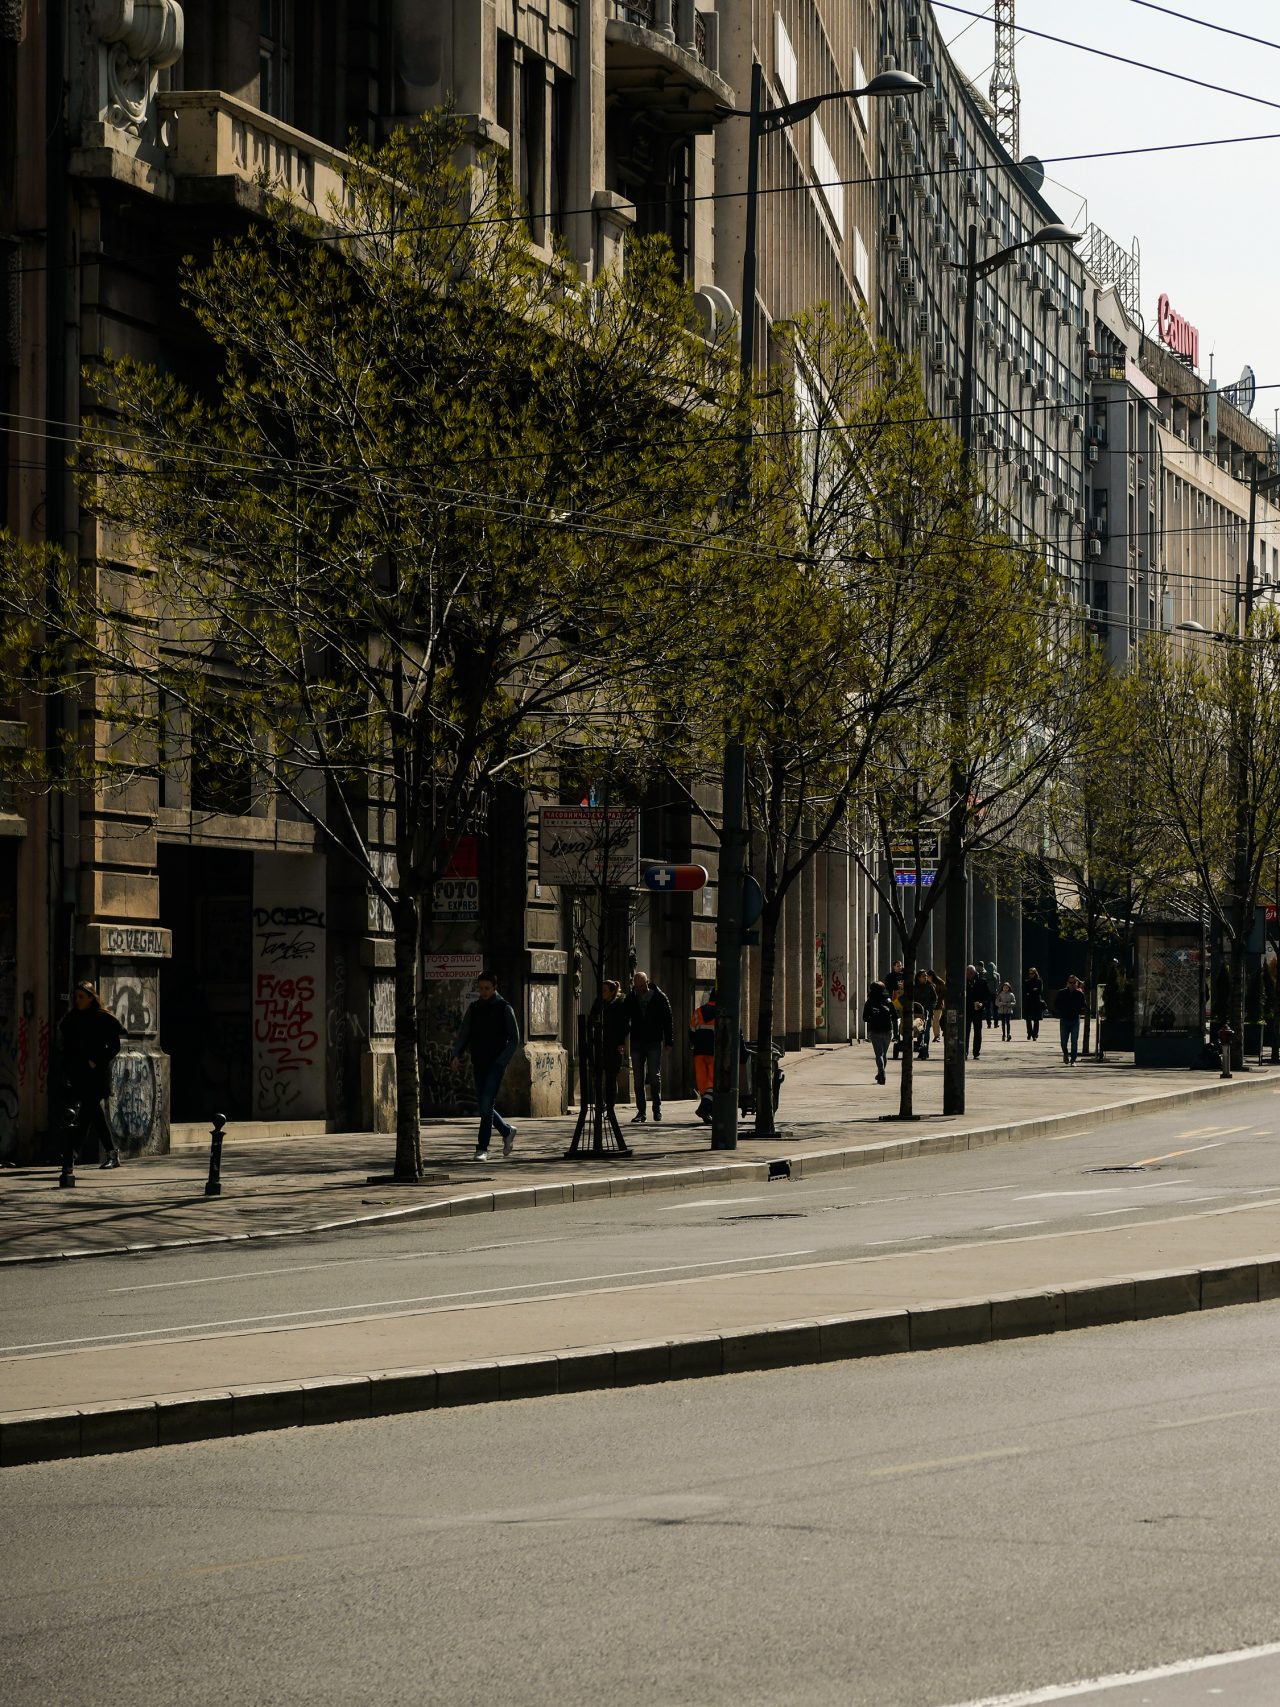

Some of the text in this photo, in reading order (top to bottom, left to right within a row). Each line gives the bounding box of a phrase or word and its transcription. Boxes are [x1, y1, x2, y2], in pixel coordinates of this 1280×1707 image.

[435, 881, 477, 899] FOTO
[448, 901, 477, 910] EXPRES
[126, 929, 163, 951] VEGAN
[426, 955, 481, 963] FOTO STUDIO
